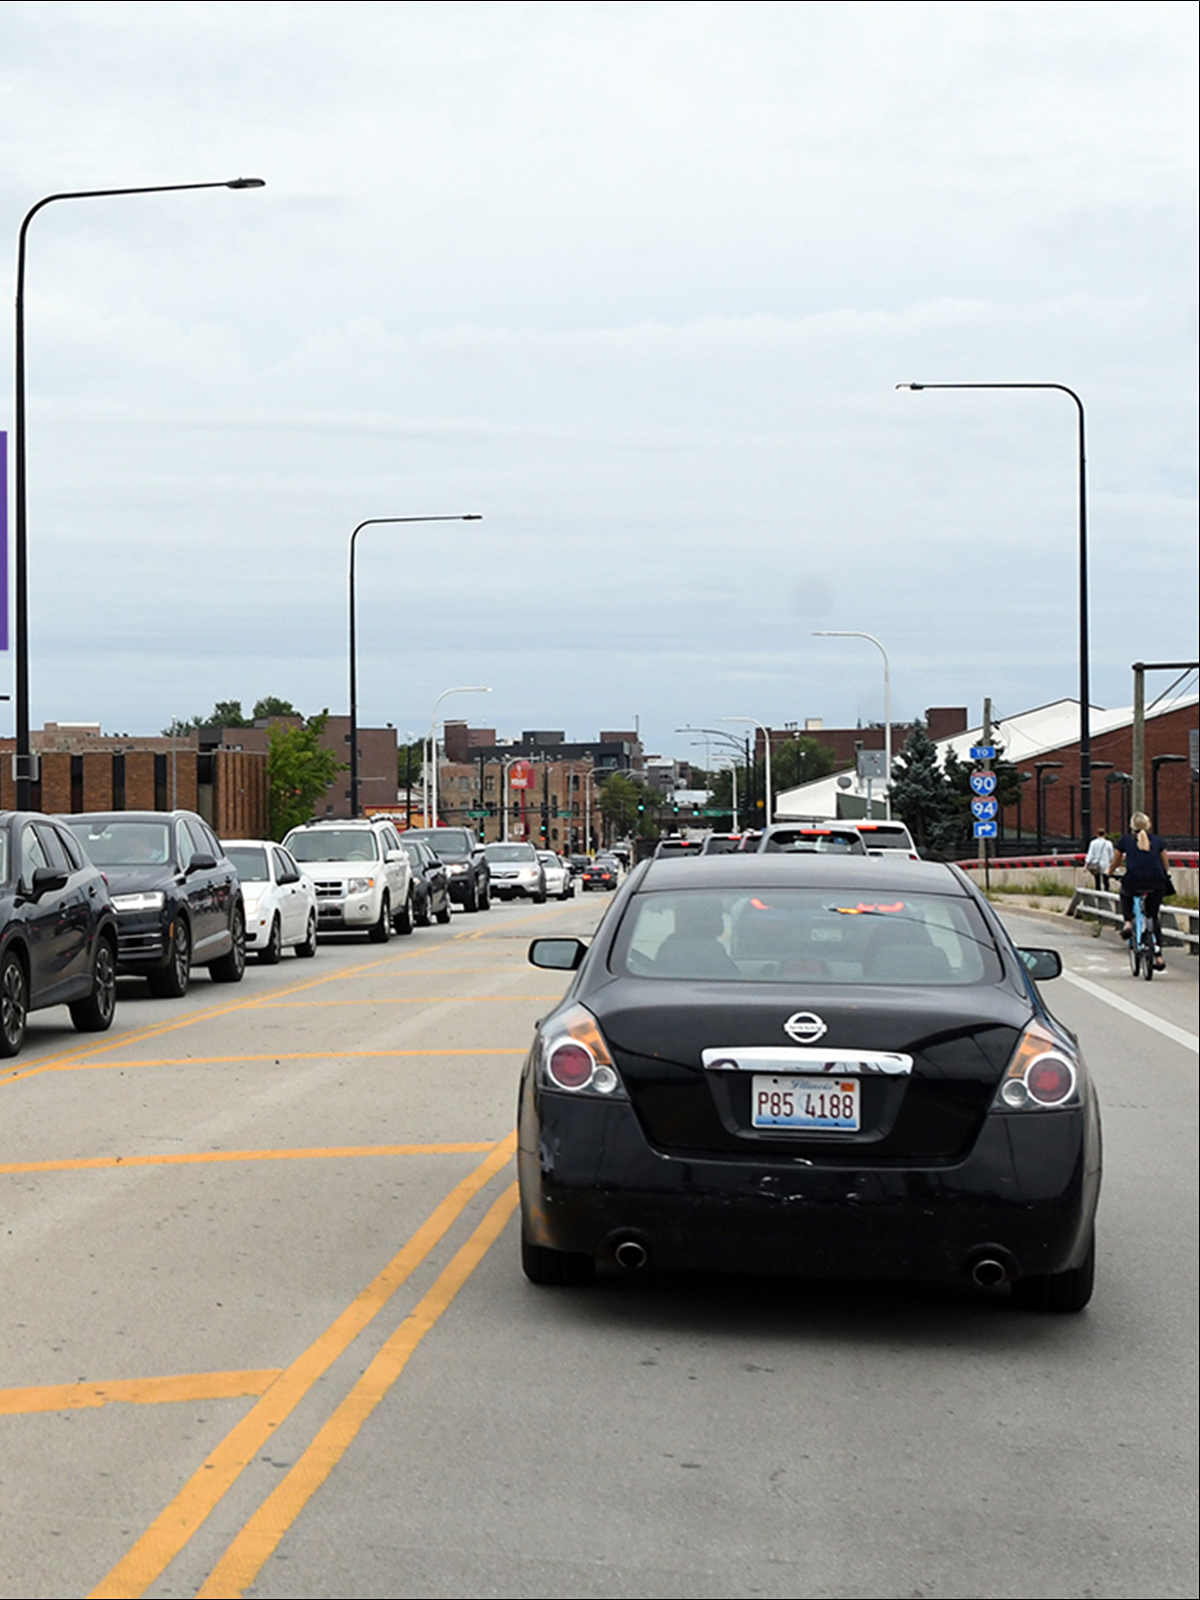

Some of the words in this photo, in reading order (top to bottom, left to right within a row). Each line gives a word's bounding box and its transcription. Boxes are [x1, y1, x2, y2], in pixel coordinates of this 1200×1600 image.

[973, 776, 994, 791] 90
[973, 802, 995, 817] 94
[757, 1091, 795, 1118] P85
[804, 1093, 855, 1120] 4188
